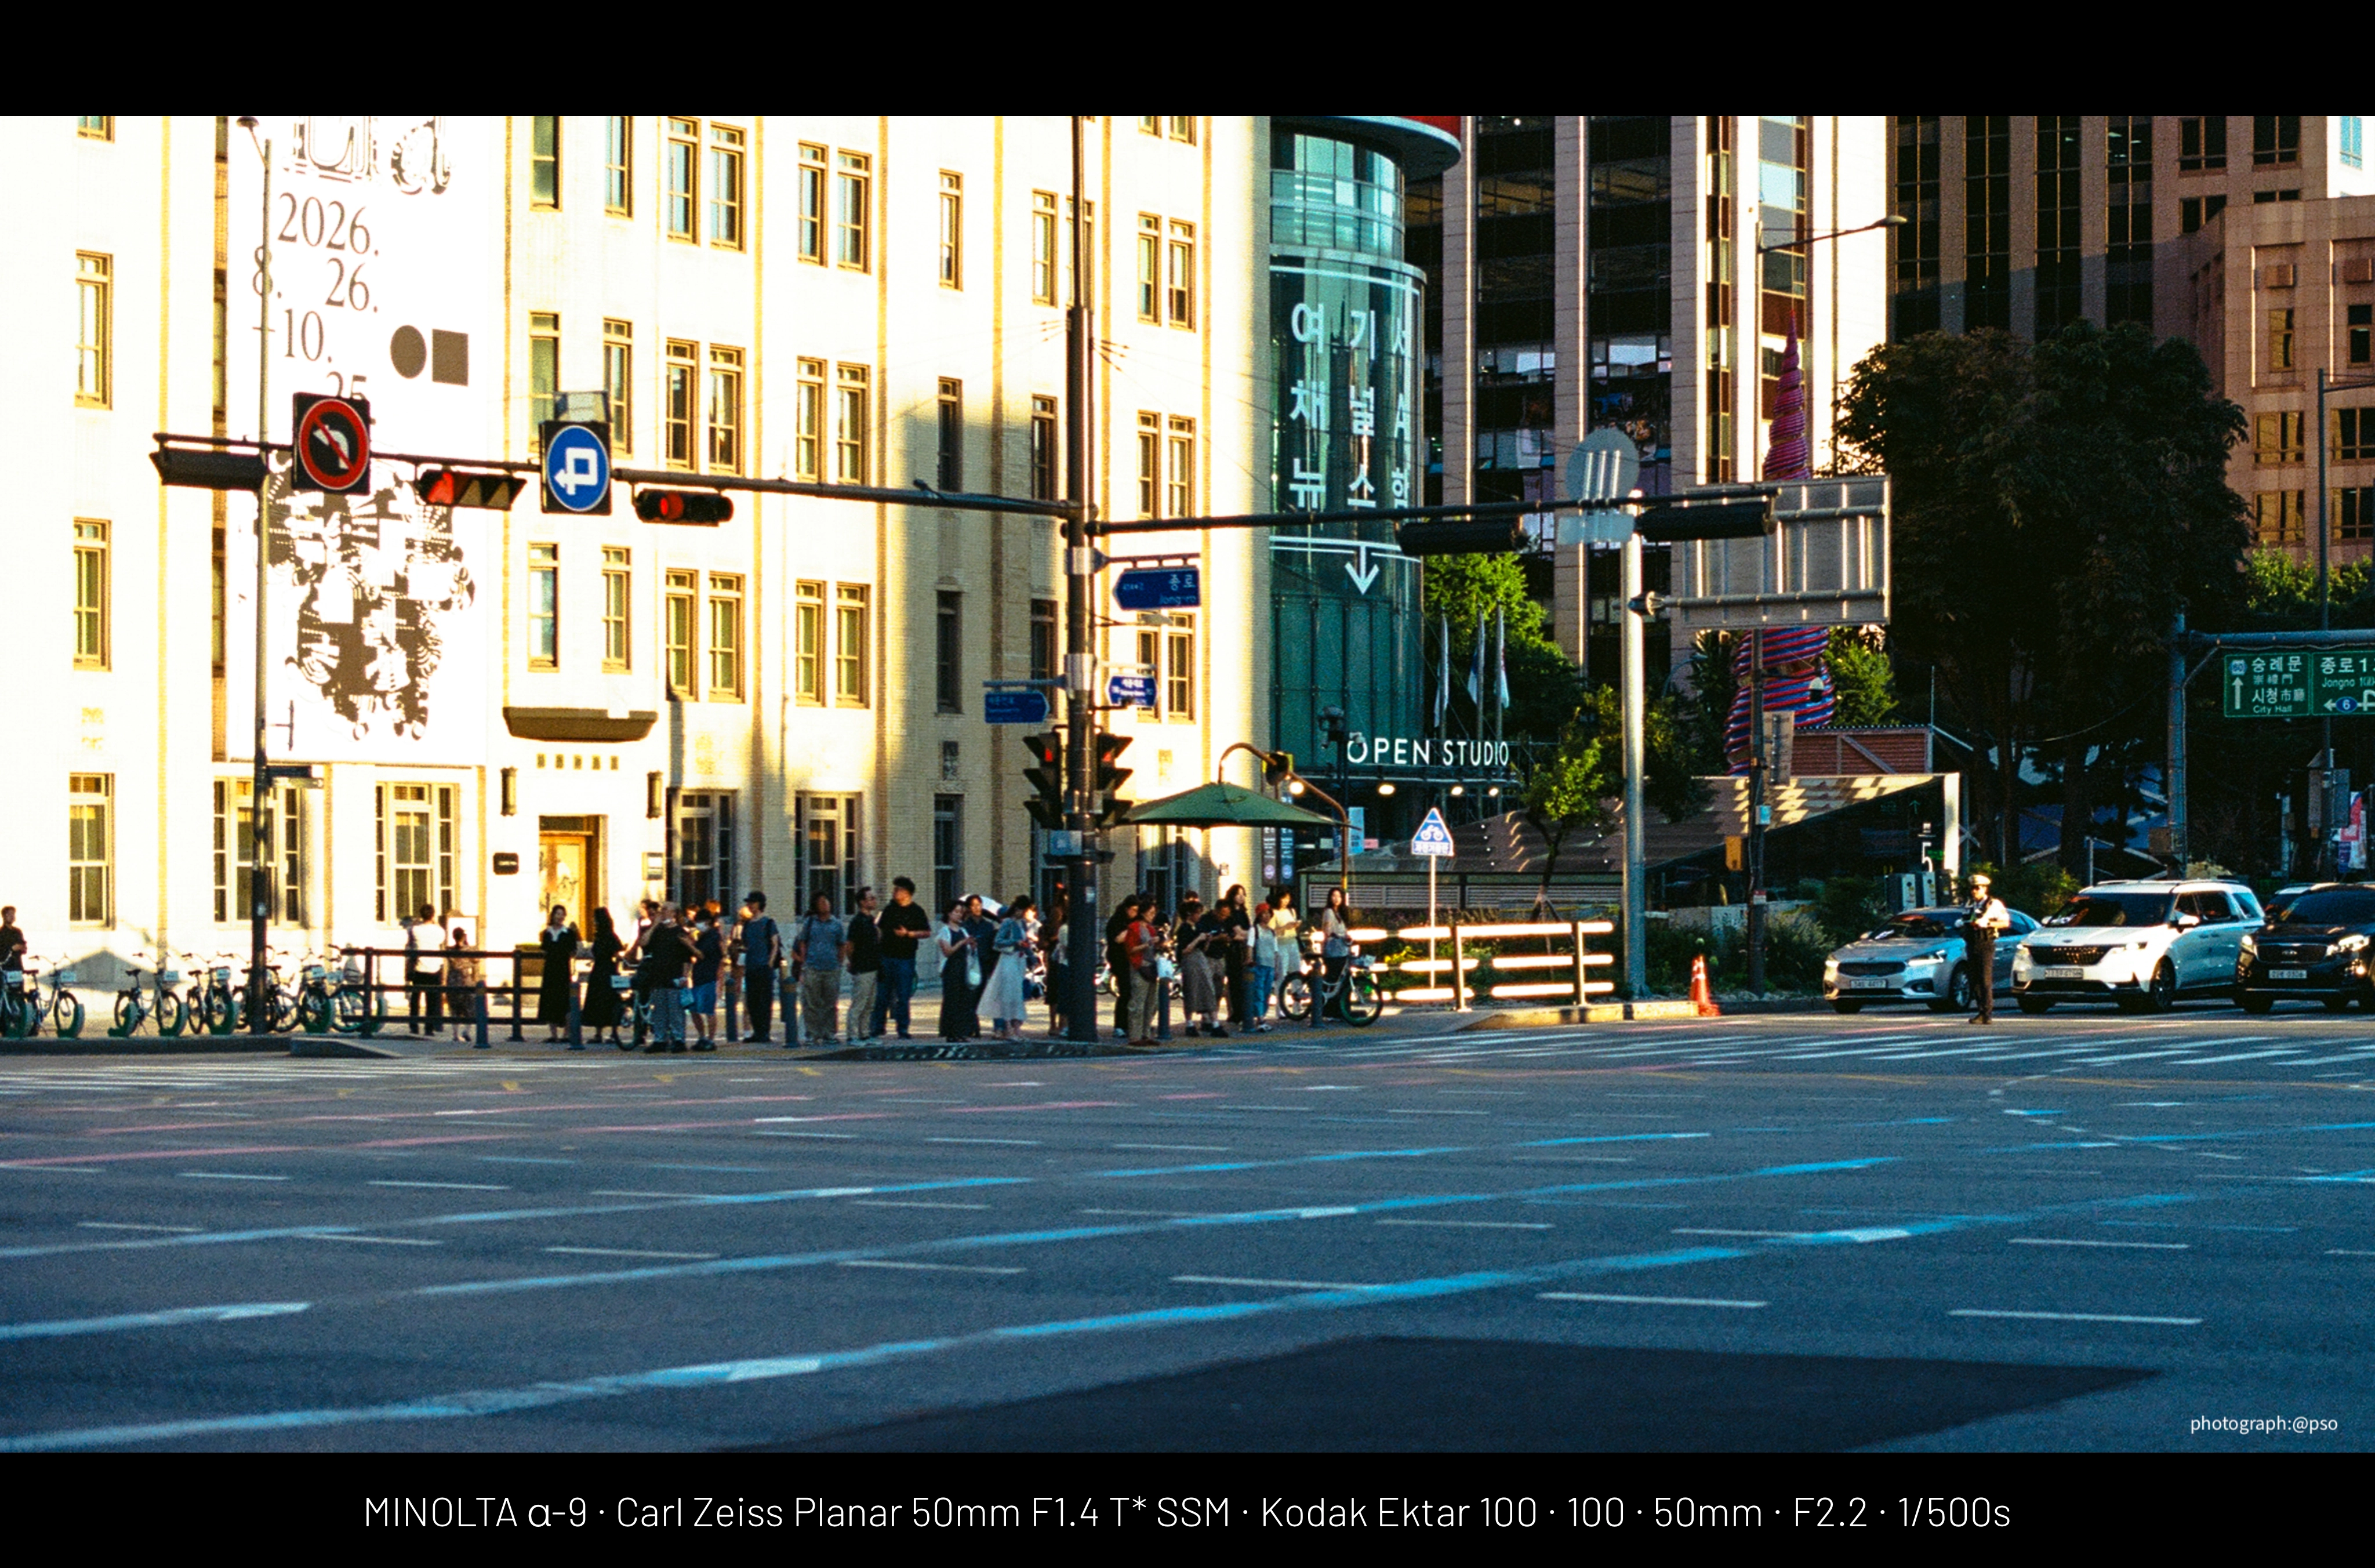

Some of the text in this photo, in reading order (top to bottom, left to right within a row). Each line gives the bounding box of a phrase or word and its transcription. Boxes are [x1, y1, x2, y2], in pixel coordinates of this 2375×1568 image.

[278, 191, 379, 256] 2026.
[325, 257, 379, 313] 26.
[1168, 574, 1196, 591] 종로
[2251, 655, 2302, 673] 숭례문
[2320, 656, 2375, 674] 종로1
[2321, 677, 2356, 691] Jongno
[2251, 687, 2278, 704] 시청
[2253, 705, 2293, 715] City Hall
[2343, 699, 2351, 710] 6
[1347, 737, 1509, 767] OPEN STUDIO
